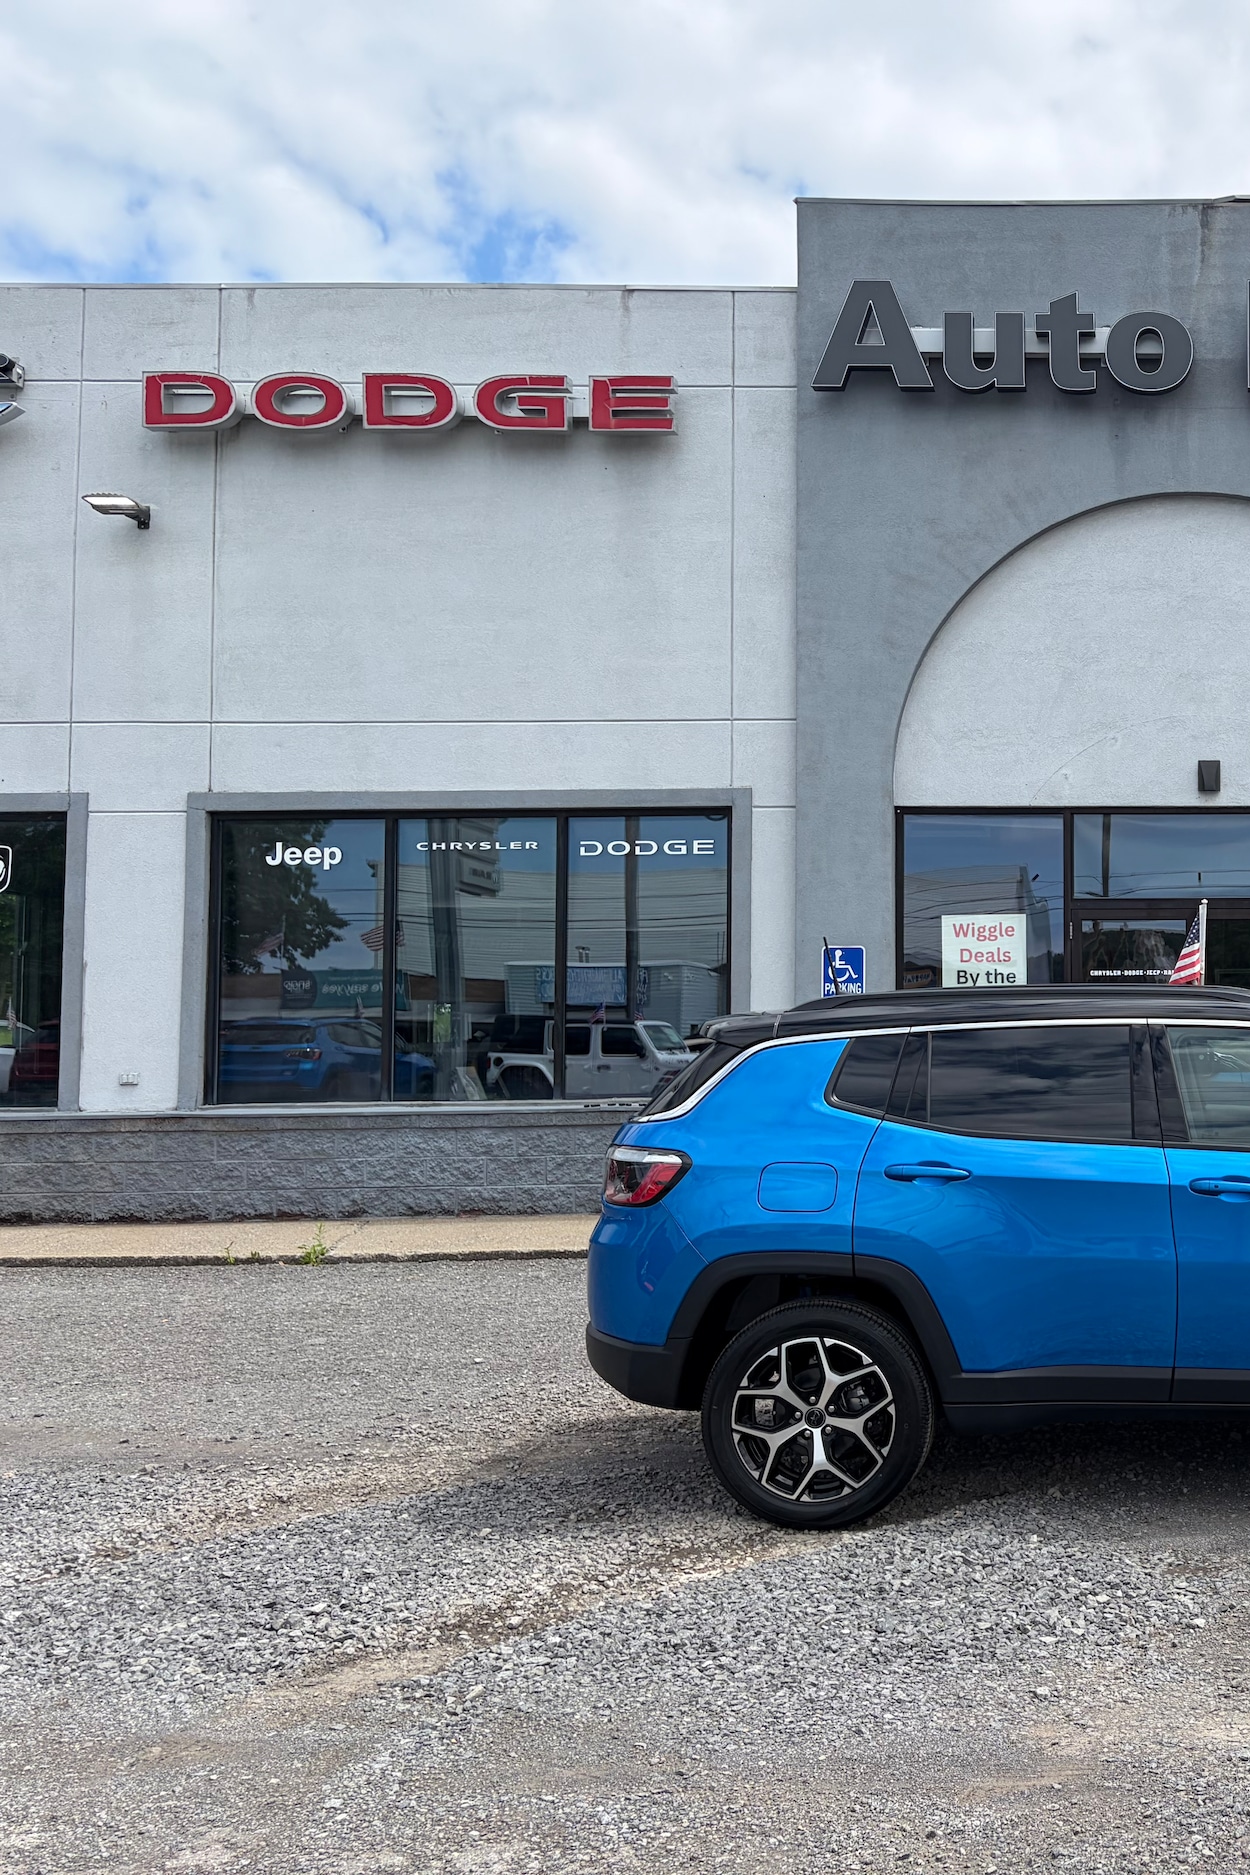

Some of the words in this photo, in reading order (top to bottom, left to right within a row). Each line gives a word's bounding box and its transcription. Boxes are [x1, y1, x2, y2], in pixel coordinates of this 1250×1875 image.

[811, 277, 1194, 392] Auto
[142, 371, 678, 435] DODGE
[265, 841, 343, 870] Jeep
[416, 841, 539, 851] CHRYSLER
[579, 839, 715, 856] DODGE
[952, 921, 1016, 942] Wiggle
[959, 947, 1012, 963] Deals
[956, 969, 980, 986] By
[985, 968, 1017, 984] the
